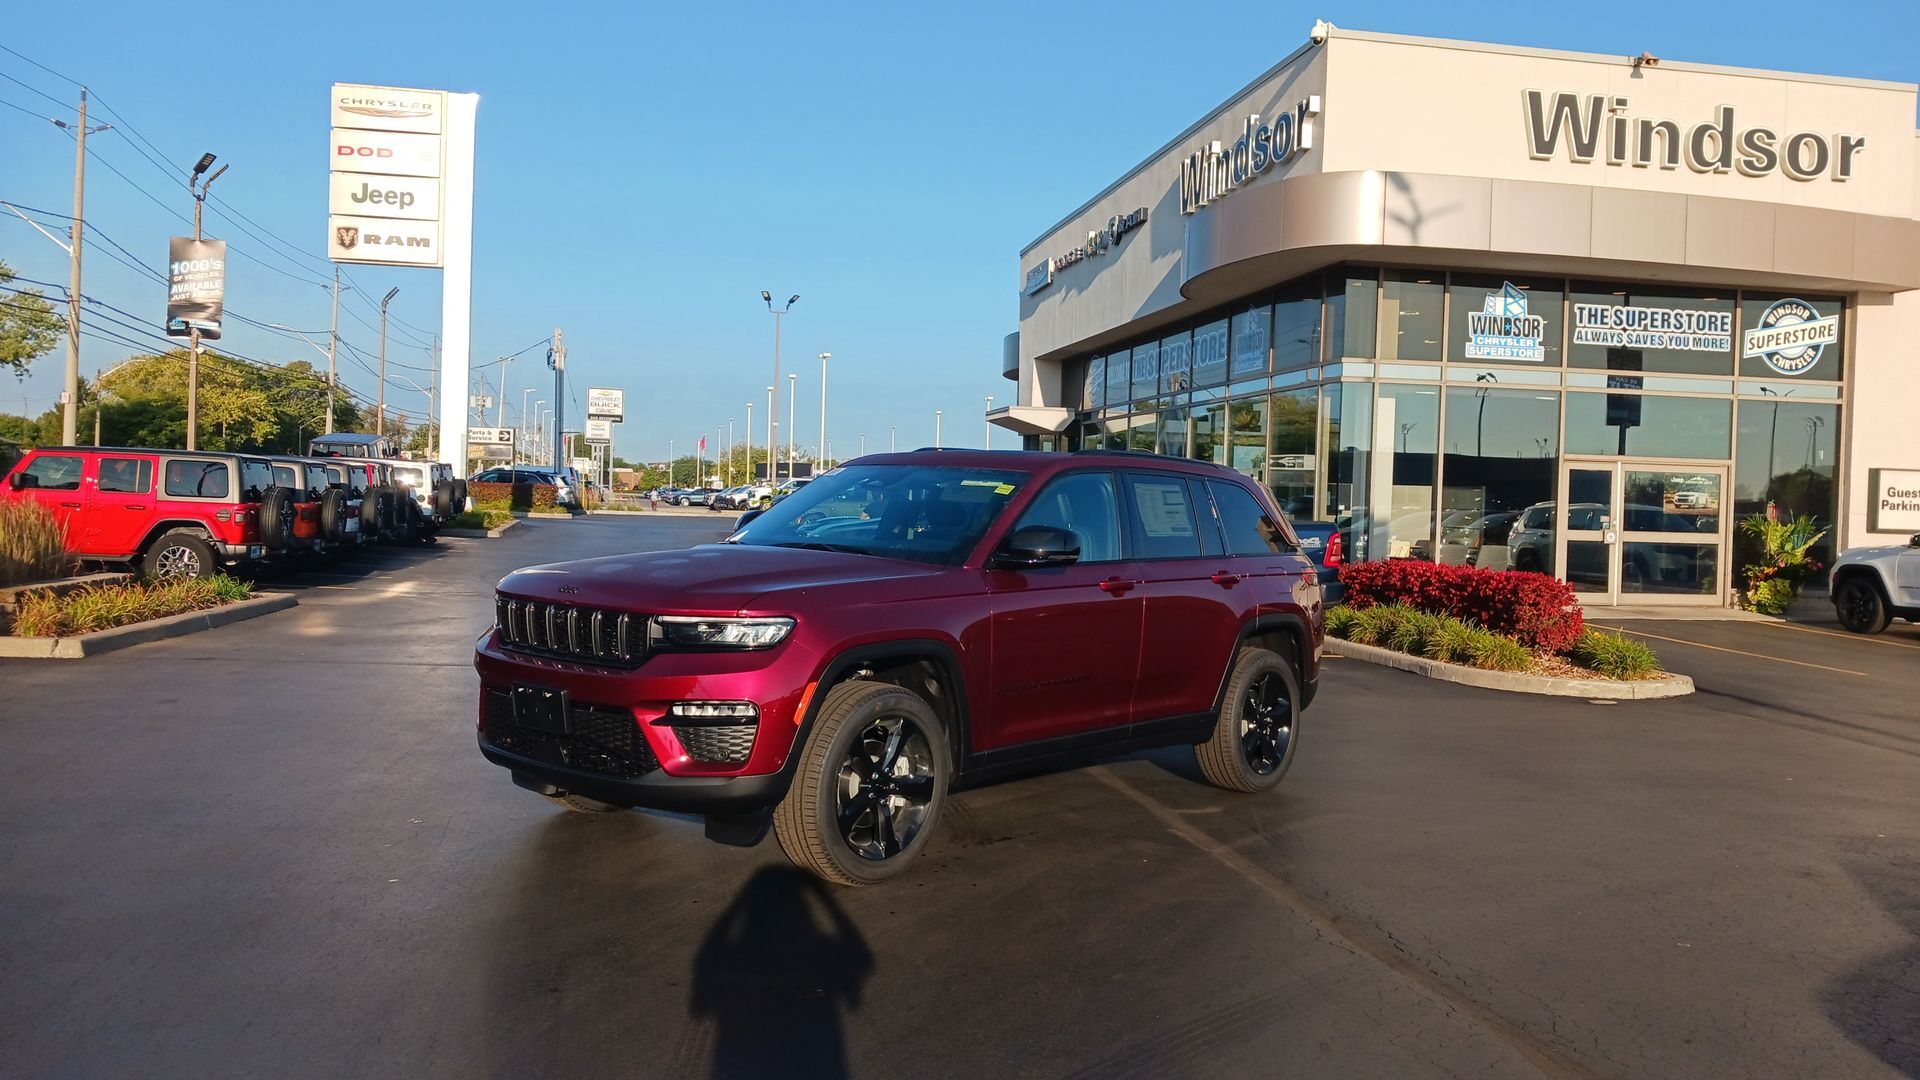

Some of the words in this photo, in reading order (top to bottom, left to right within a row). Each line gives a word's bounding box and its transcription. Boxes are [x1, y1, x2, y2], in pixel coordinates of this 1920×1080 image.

[340, 97, 433, 110] CHRYSLER
[1521, 88, 1868, 183] Windsor
[1180, 95, 1320, 215] Windsor
[351, 183, 415, 210] Jeep
[363, 234, 430, 248] RAM
[171, 259, 222, 275] 1000's
[171, 280, 221, 294] AVAILABLE
[171, 292, 190, 301] JUST
[1577, 306, 1609, 326] THE
[1613, 308, 1731, 333] SUPERSTORE
[1766, 304, 1810, 325] WINDSOR
[1471, 315, 1541, 338] WINDSOR
[1477, 336, 1534, 347] CHRYSLER
[1576, 330, 1623, 343] ALWAYS
[1627, 332, 1664, 346] SAVES
[1668, 335, 1690, 347] YOU
[1692, 336, 1730, 349] MORE!
[1748, 324, 1834, 350] SUPERSTORE
[1469, 346, 1541, 358] SUPERSTORE
[1772, 348, 1816, 370] CHRYSLER
[1881, 499, 1920, 511] Parkin
